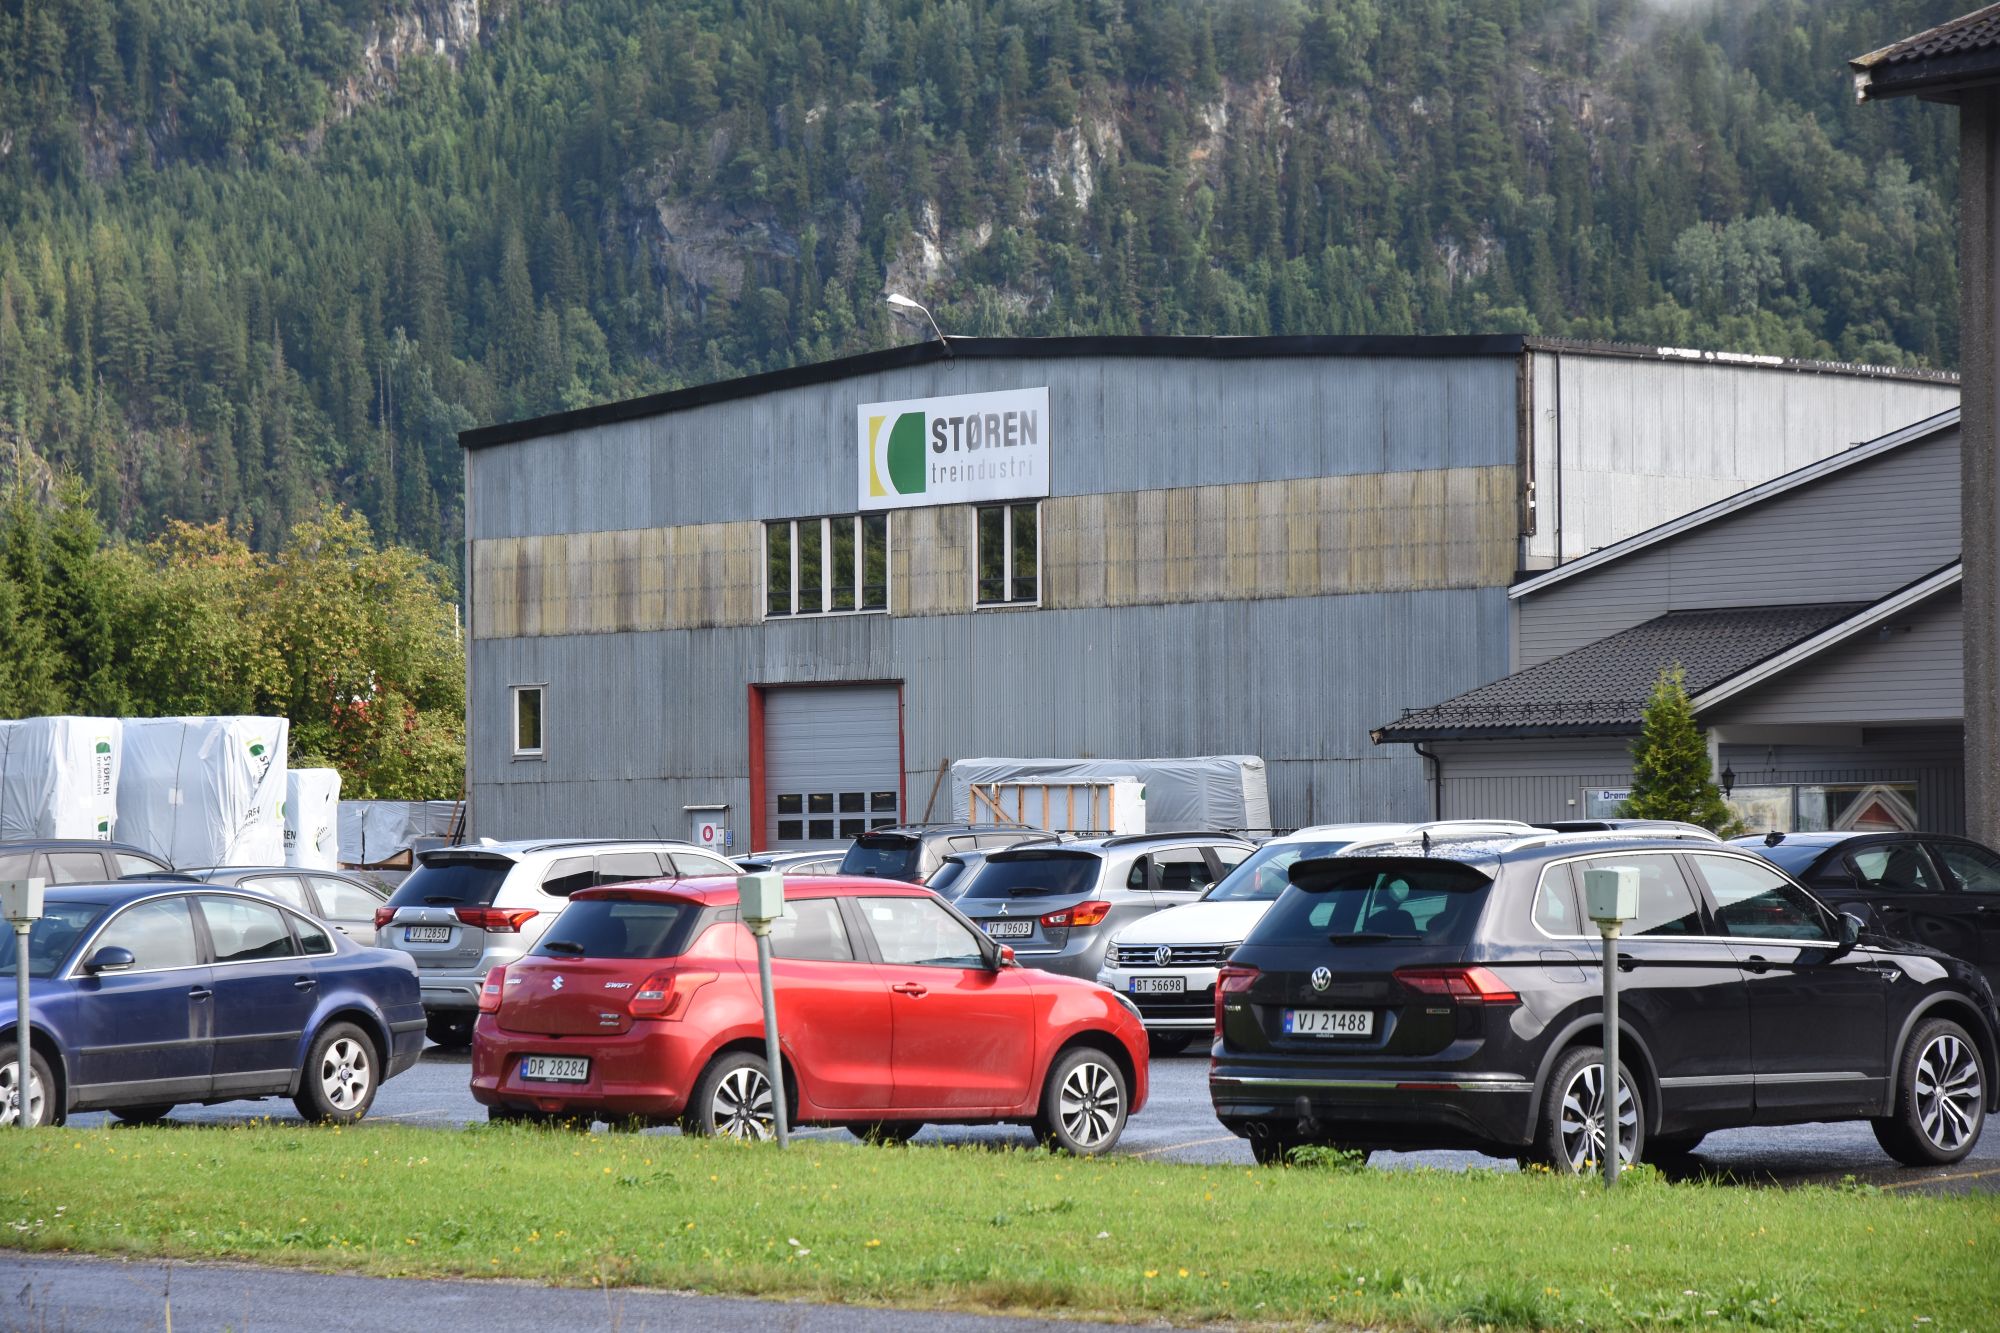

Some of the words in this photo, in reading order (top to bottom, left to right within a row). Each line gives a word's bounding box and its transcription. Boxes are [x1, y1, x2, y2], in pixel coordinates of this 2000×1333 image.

[931, 410, 1038, 453] STØREN
[931, 455, 1033, 484] treindustri
[412, 927, 421, 938] VJ
[424, 928, 447, 938] 12850
[989, 923, 1000, 934] VT
[1003, 923, 1029, 933] 19603
[1136, 980, 1147, 991] BT
[1151, 979, 1181, 991] 56698
[1299, 1013, 1315, 1031] VJ
[1321, 1013, 1366, 1032] 21488
[529, 1059, 545, 1075] DR
[549, 1060, 585, 1077] 28284
